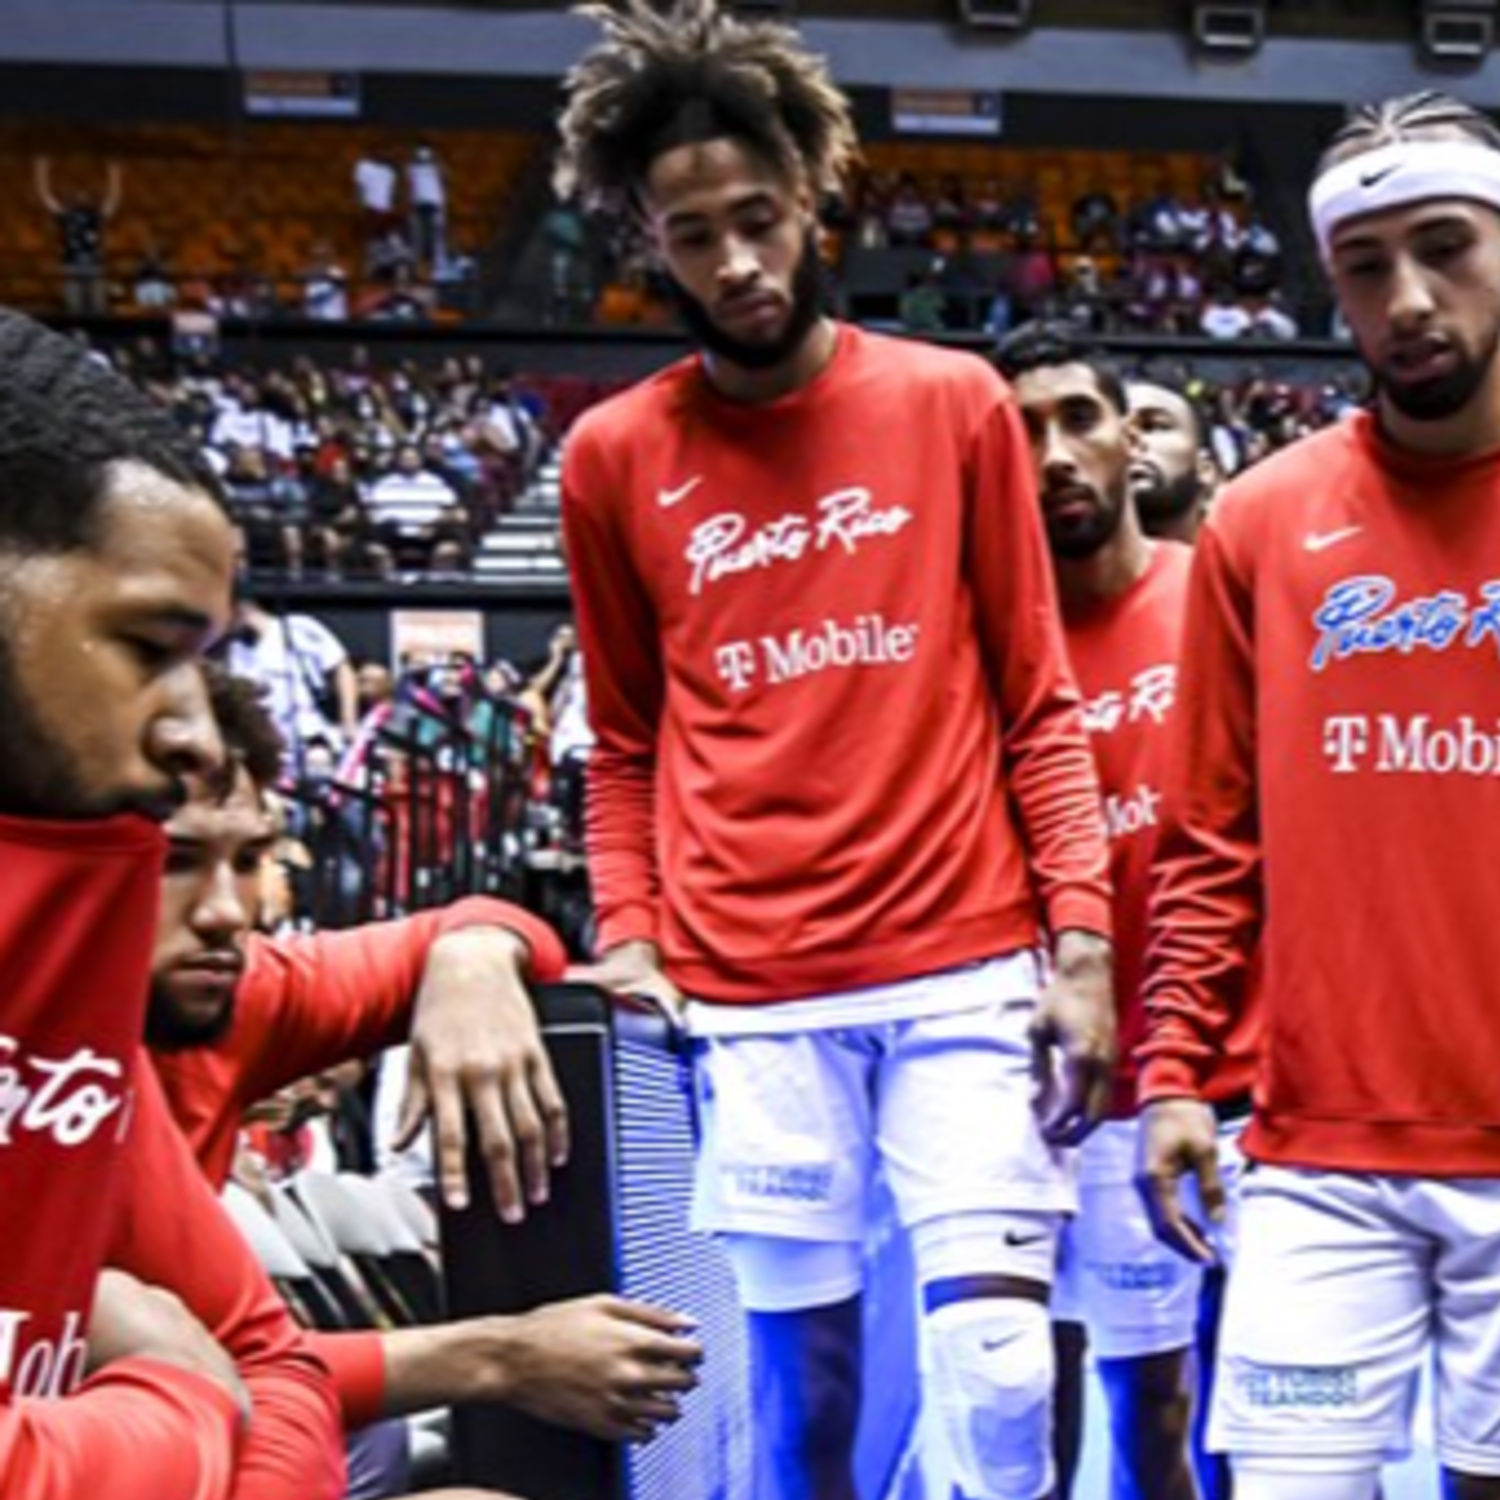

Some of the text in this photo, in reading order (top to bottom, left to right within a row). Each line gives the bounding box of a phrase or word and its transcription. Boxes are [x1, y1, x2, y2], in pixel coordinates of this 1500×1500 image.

[684, 486, 912, 596] Puerto Rico
[758, 612, 914, 684] Mobile
[1308, 575, 1468, 671] Puerto
